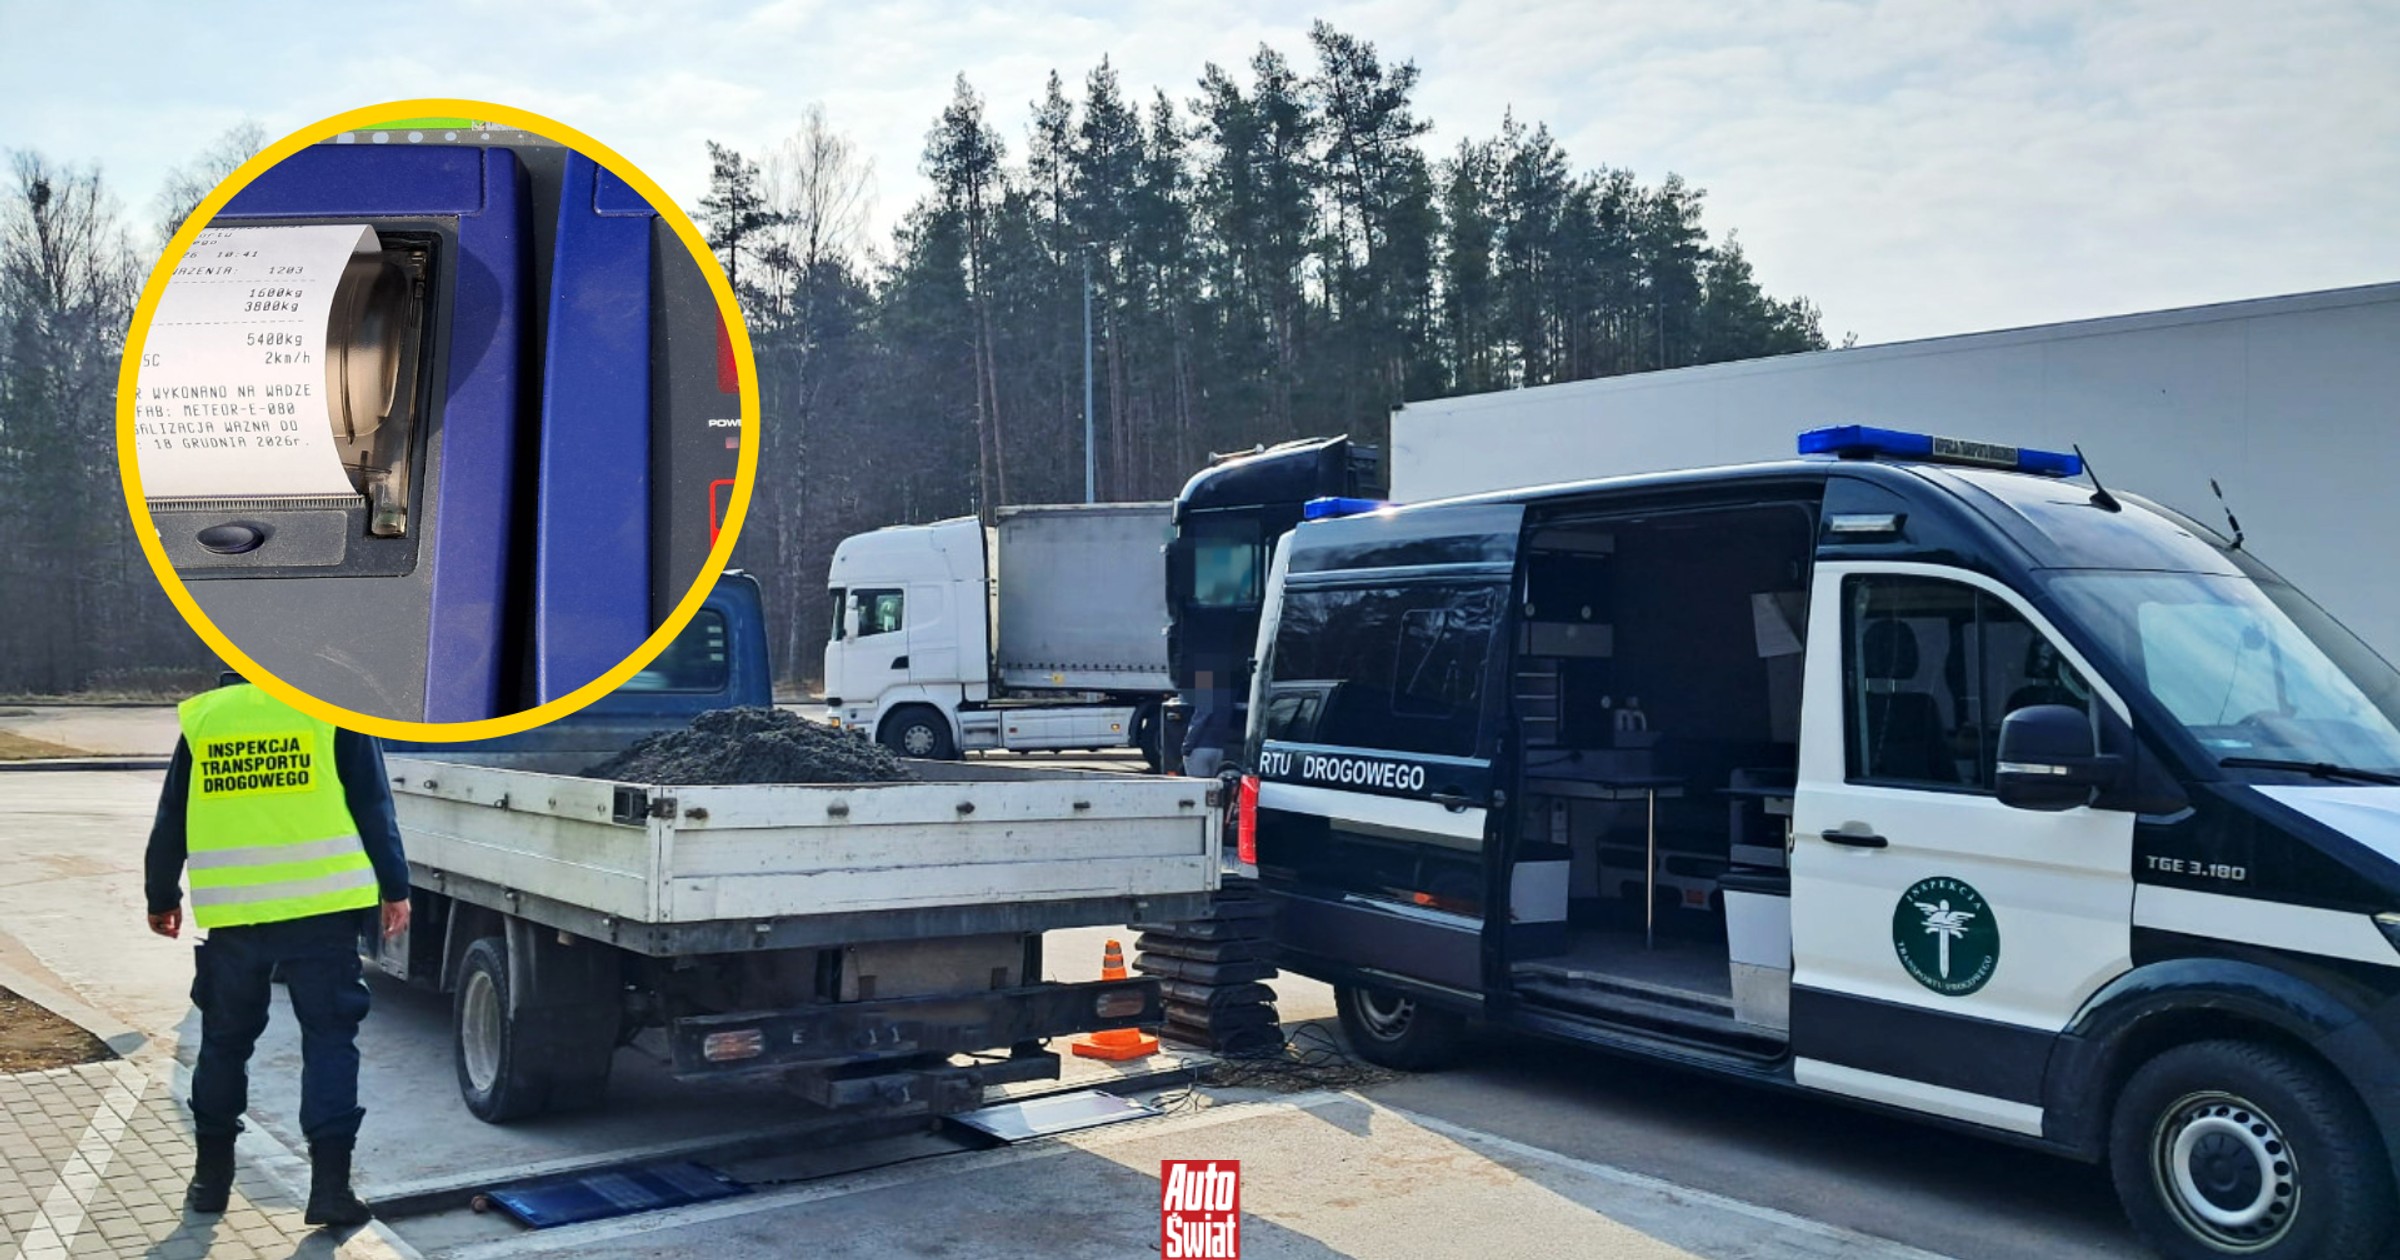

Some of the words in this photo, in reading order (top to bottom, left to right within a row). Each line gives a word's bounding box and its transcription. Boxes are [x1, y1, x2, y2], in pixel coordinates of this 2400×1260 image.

[249, 288, 302, 298] 1600kg
[244, 301, 299, 312] 3800kg
[247, 333, 302, 346] 5400kg
[265, 351, 310, 364] 2km/h
[152, 385, 227, 399] WYKONANO
[237, 385, 255, 397] NA
[224, 421, 270, 432] WAZNA
[280, 420, 298, 431] DO
[182, 437, 246, 449] GRUDNIA
[208, 737, 300, 758] INSPEKCJA
[201, 753, 311, 776] TRANSPORTU
[1258, 751, 1291, 775] RTU
[1303, 755, 1425, 790] DROGOWEGO
[204, 770, 309, 793] DROGOWEGO
[2147, 855, 2184, 873] TGE
[2188, 860, 2246, 880] 3.180
